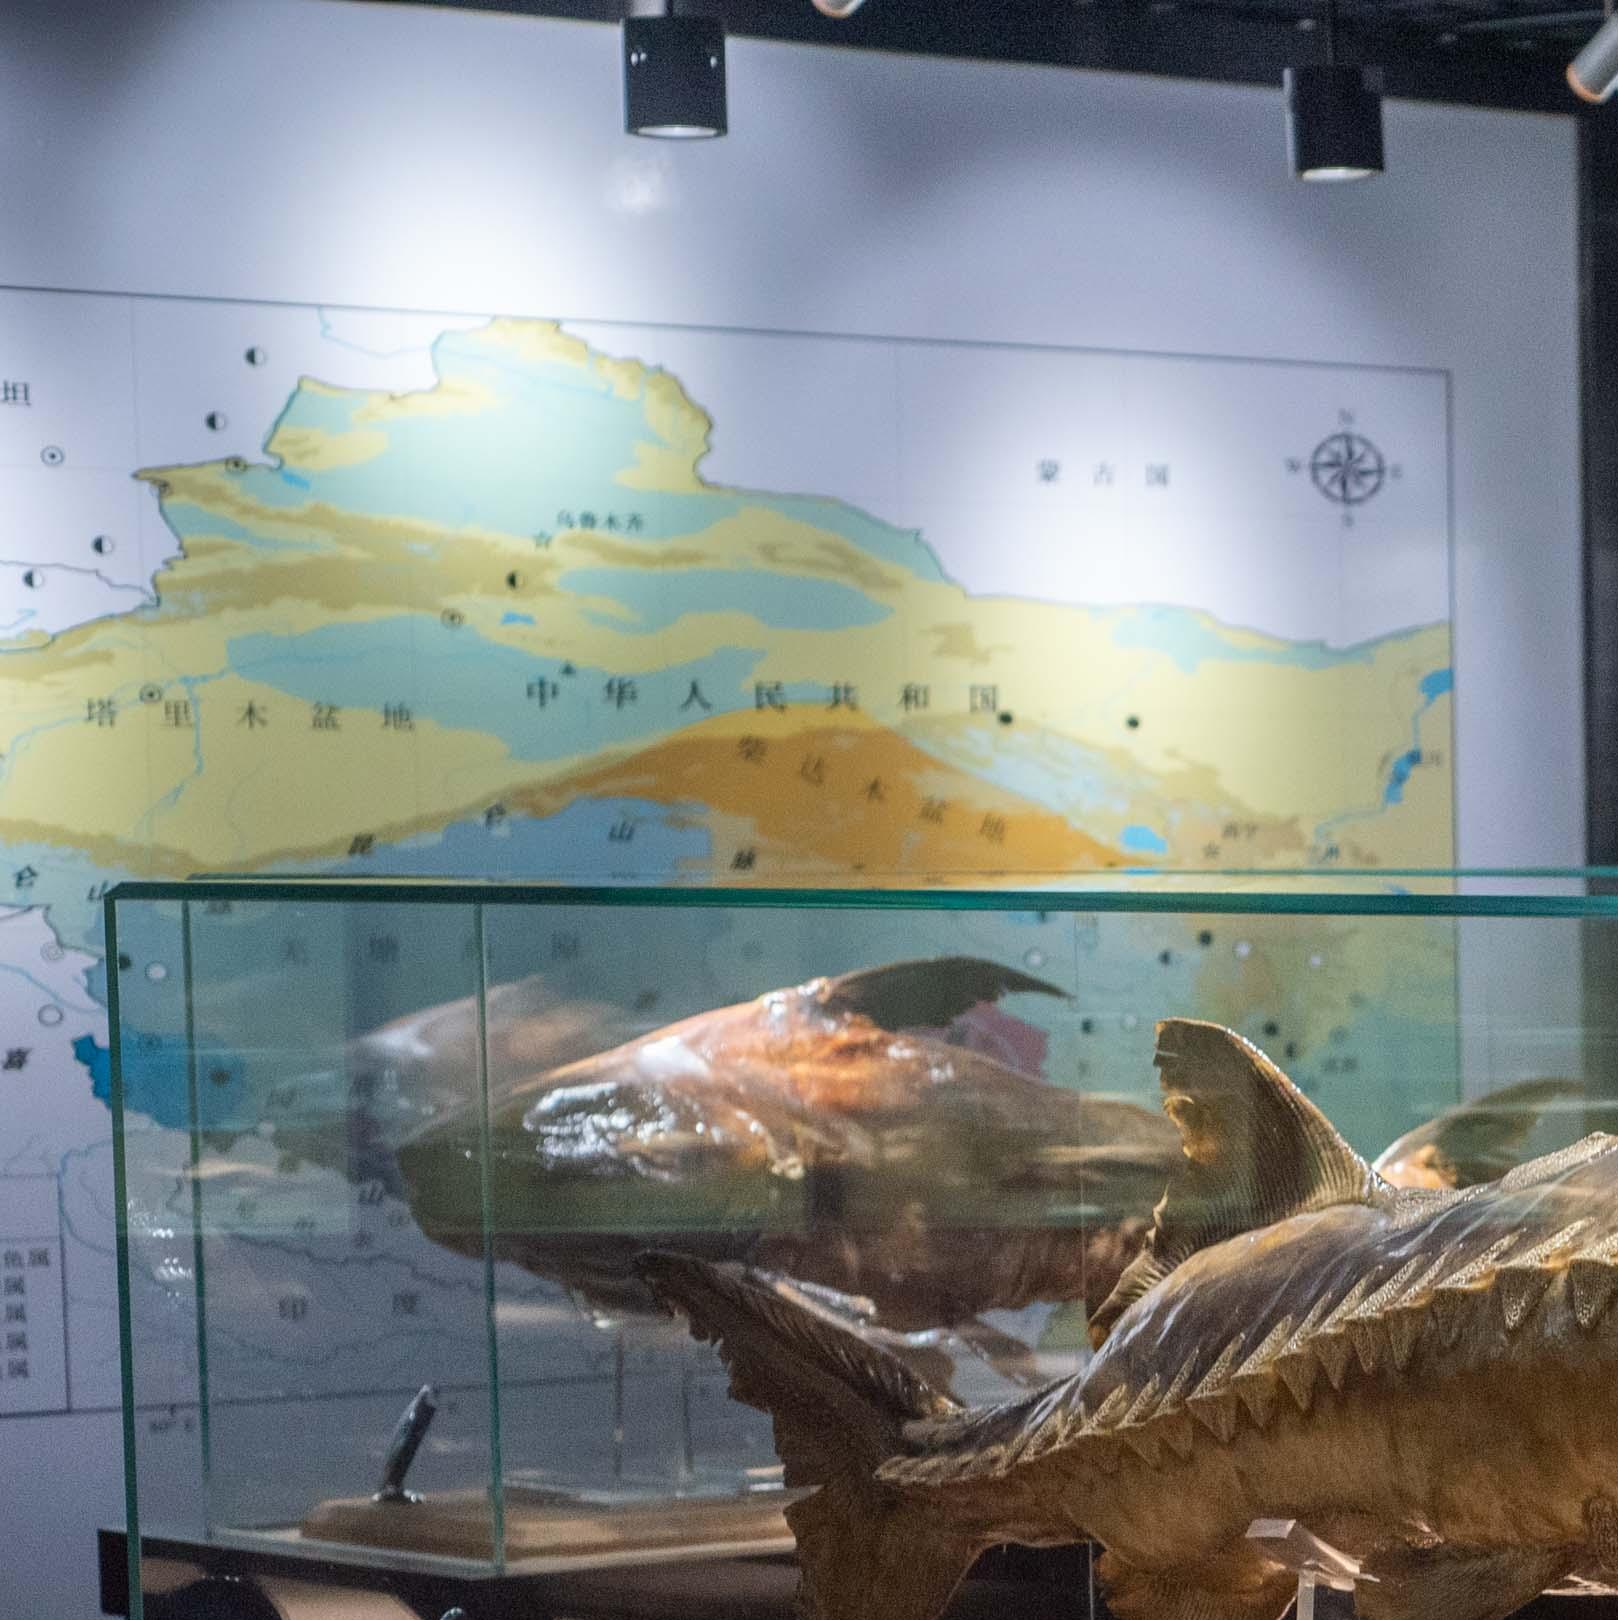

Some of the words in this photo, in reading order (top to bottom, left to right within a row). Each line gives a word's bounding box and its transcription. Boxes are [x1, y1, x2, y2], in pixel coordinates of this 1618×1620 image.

[526, 679, 997, 714] 中华人民共和国
